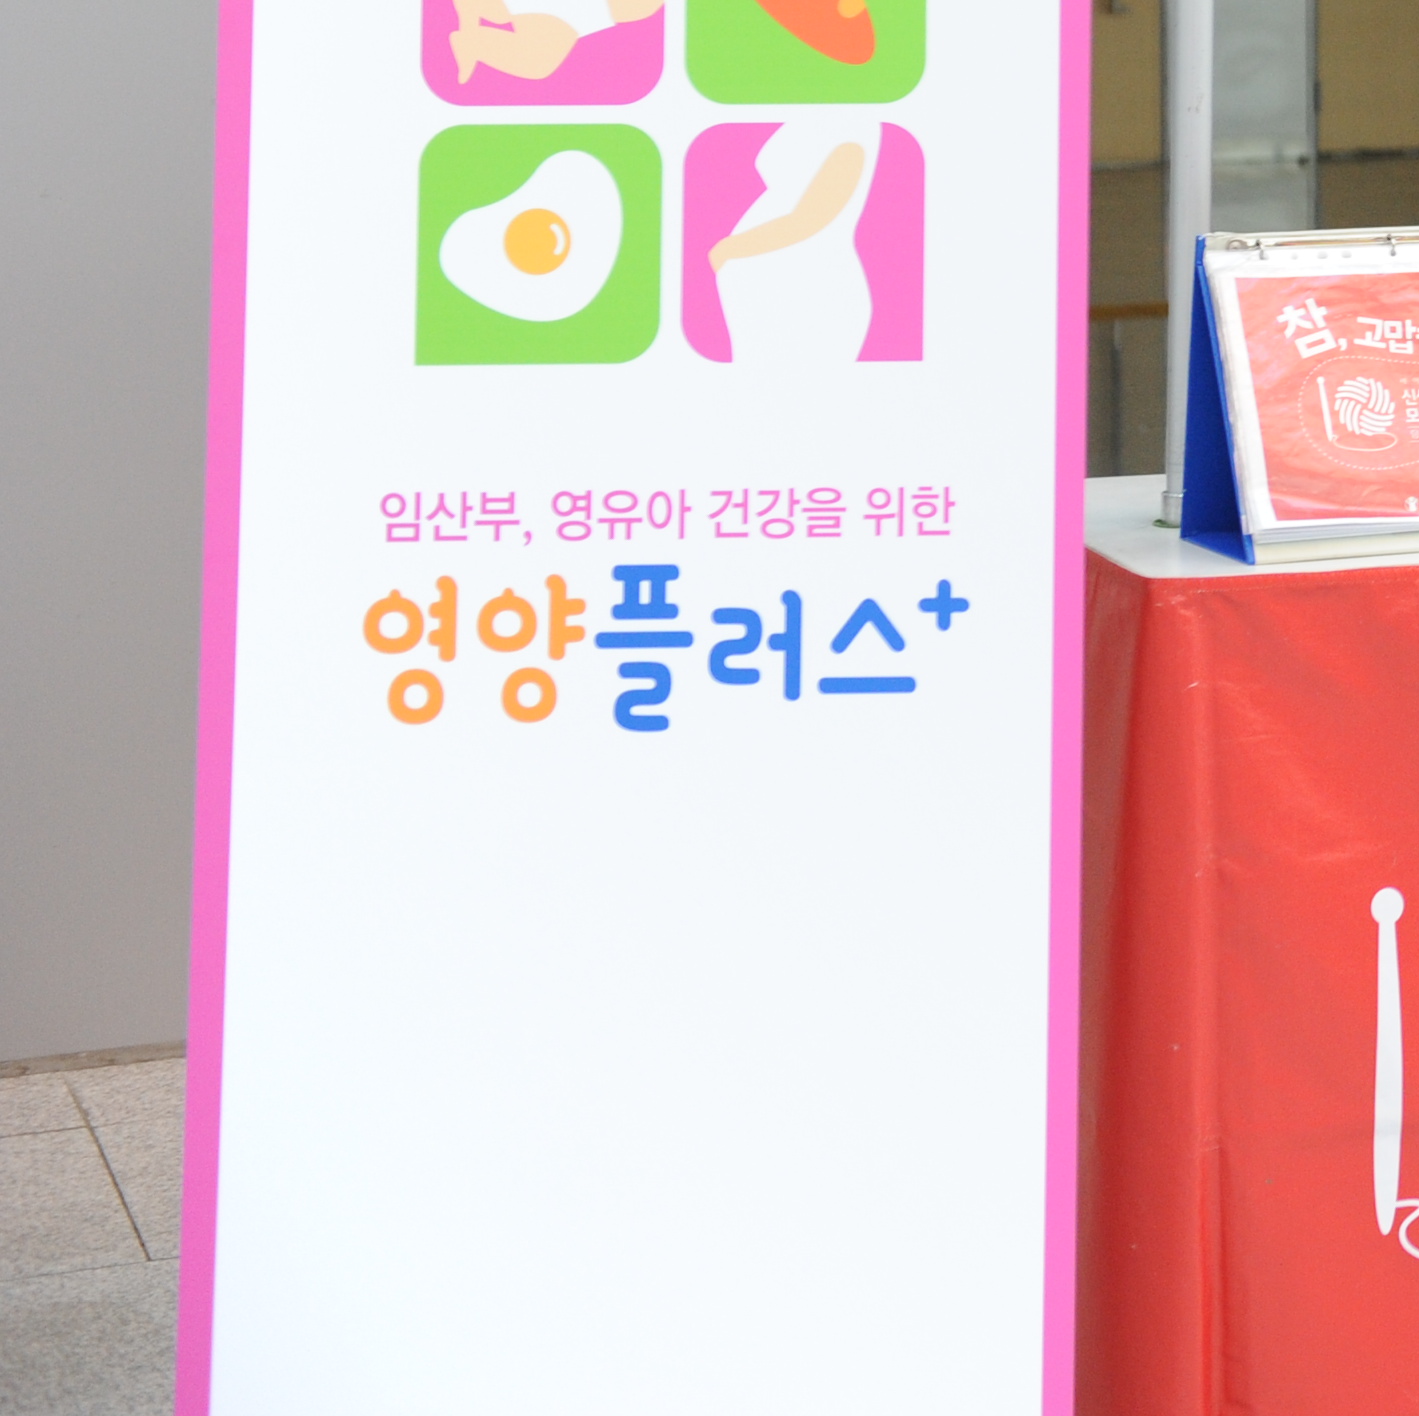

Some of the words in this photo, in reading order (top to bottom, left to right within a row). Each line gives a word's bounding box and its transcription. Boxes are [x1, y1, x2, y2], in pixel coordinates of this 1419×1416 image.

[1277, 298, 1348, 360] 참,
[379, 490, 533, 547] 임산부,
[551, 488, 693, 541] 영유아
[708, 487, 847, 540] 건강을
[862, 485, 956, 538] 위한
